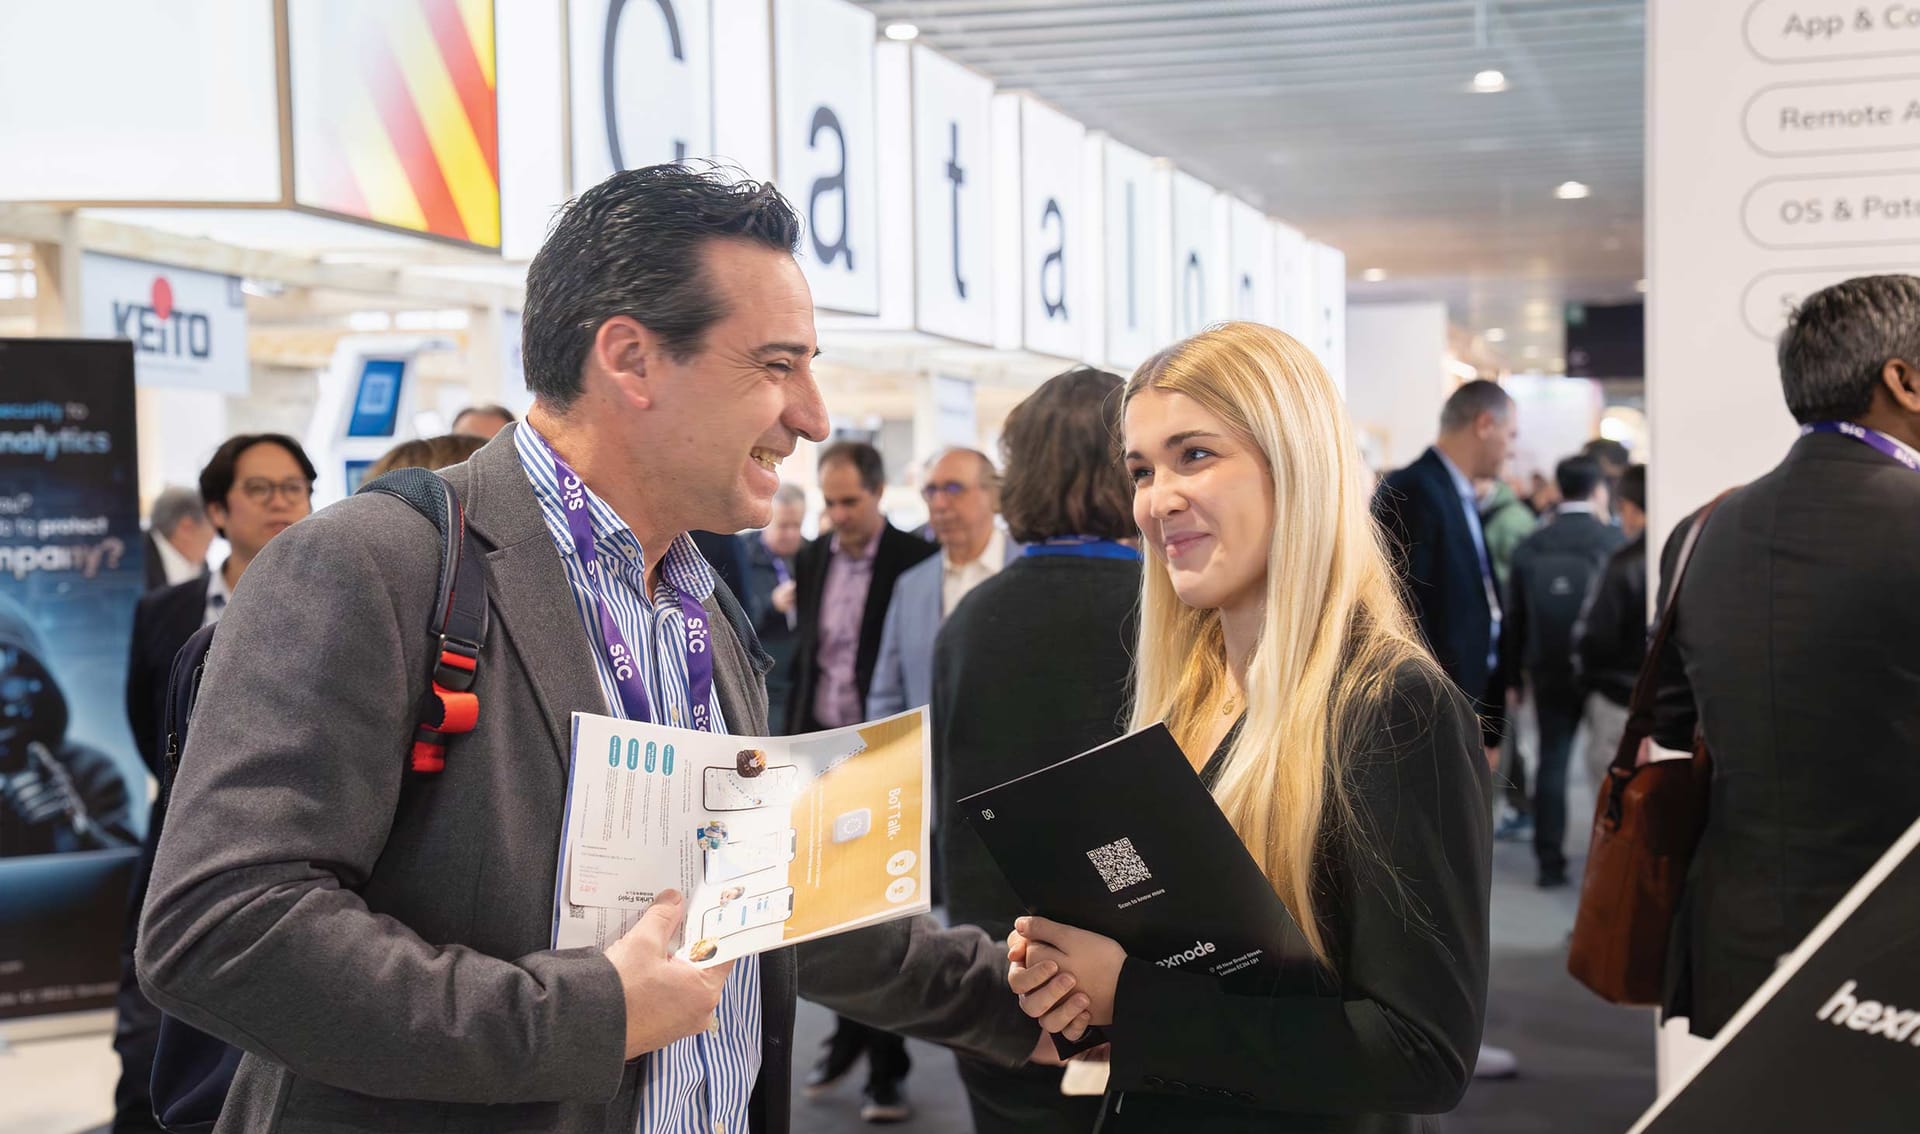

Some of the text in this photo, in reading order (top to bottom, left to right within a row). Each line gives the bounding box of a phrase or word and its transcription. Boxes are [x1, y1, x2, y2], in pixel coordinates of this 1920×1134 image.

[1783, 11, 1844, 41] App
[1853, 7, 1873, 31] &
[1780, 105, 1893, 131] Remote
[1780, 198, 1823, 224] OS
[1834, 197, 1853, 221] &
[563, 475, 584, 511] stc
[687, 617, 708, 654] stc
[609, 643, 633, 681] stc
